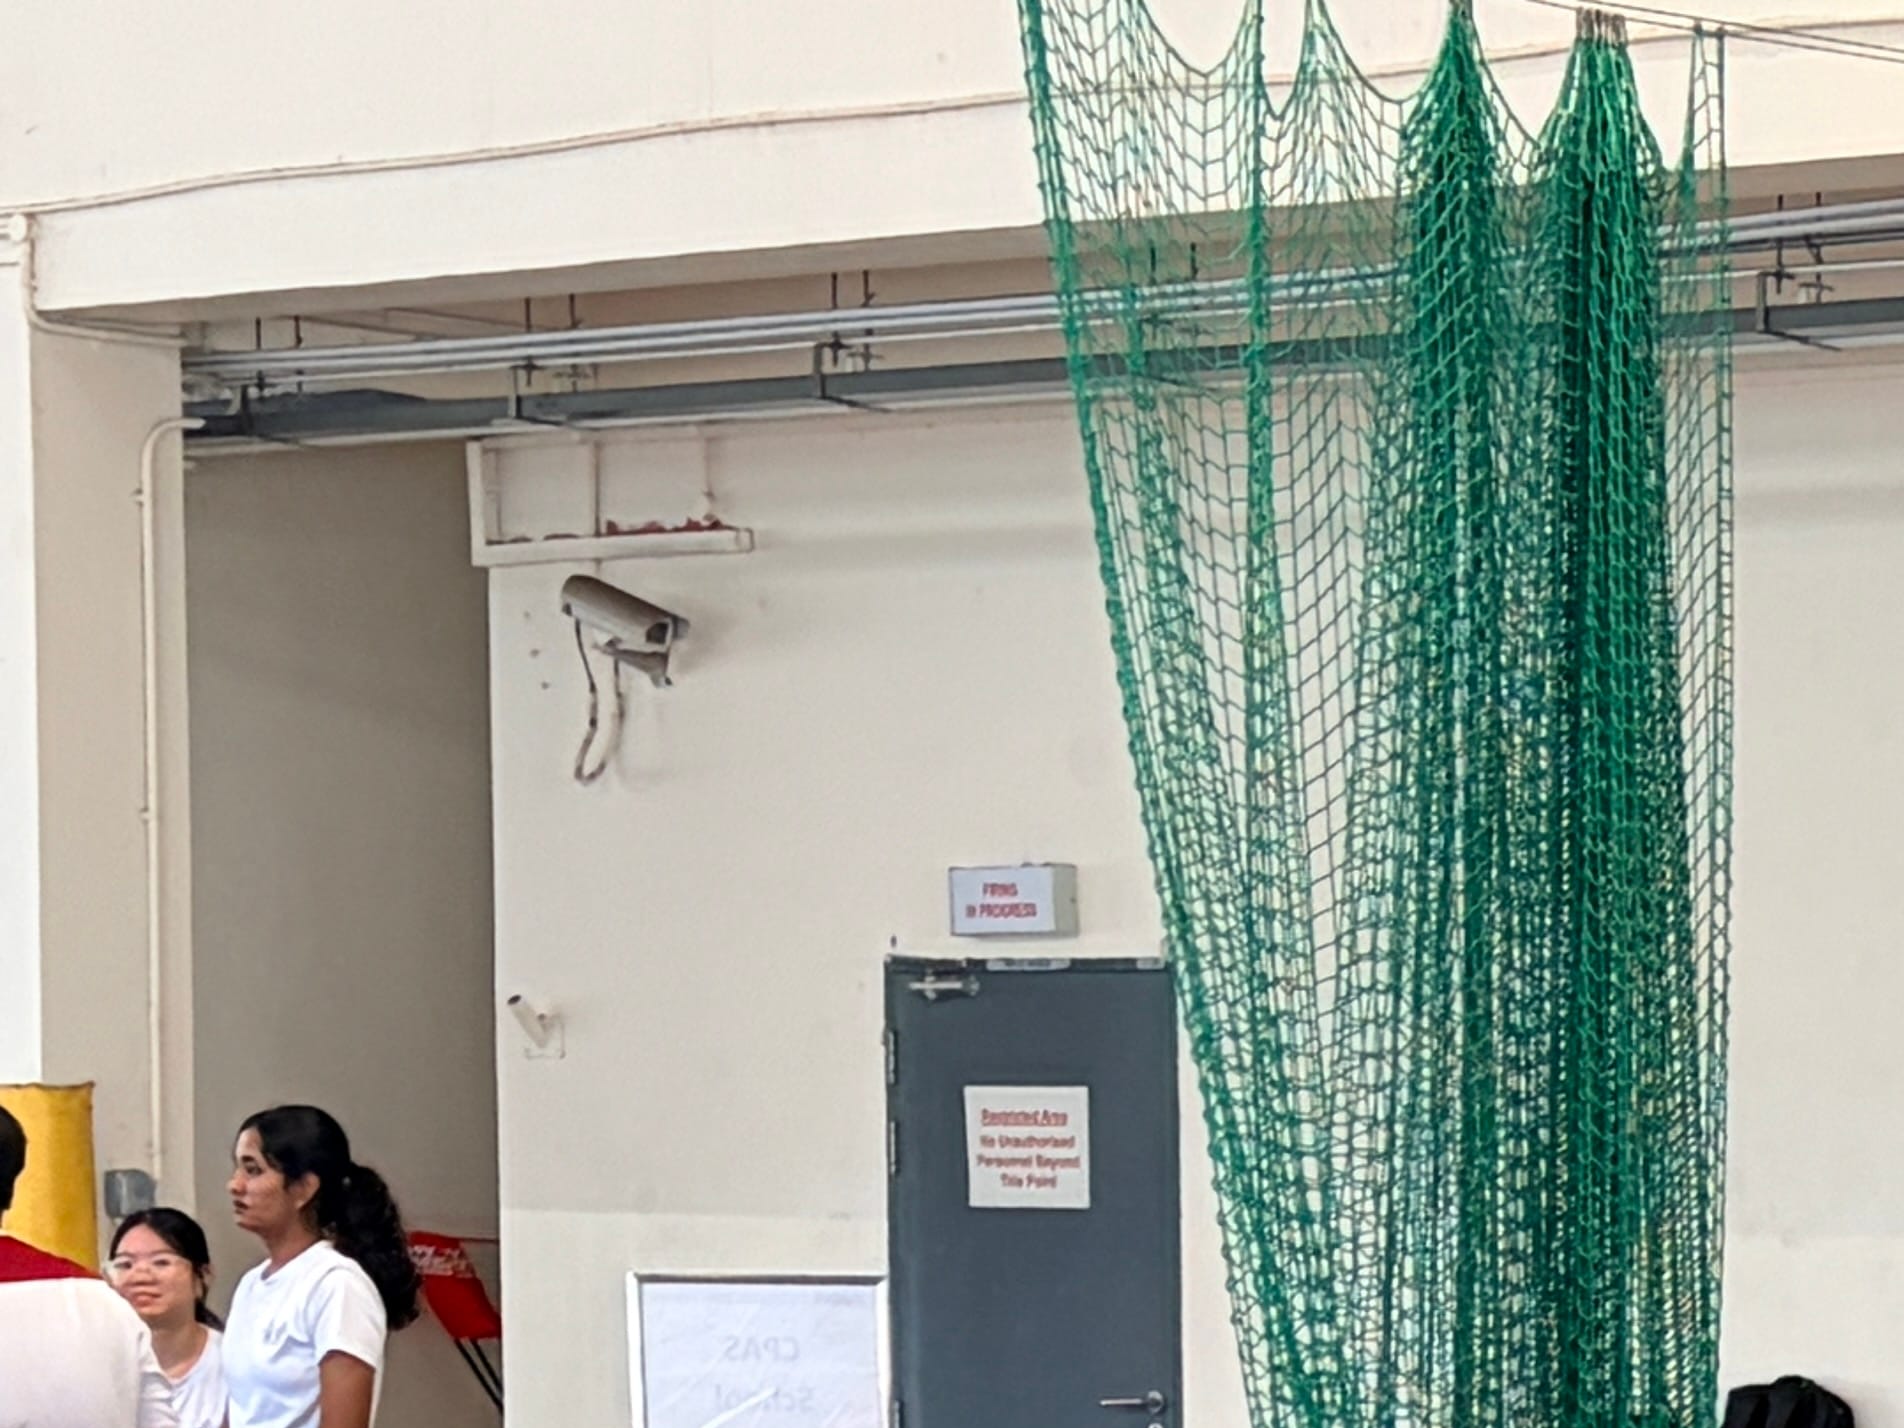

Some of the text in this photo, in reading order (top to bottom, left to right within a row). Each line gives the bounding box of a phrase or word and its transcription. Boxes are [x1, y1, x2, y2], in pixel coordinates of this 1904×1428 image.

[982, 882, 1018, 897] FIRING
[980, 903, 1037, 918] PROGRESS
[1041, 1109, 1068, 1127] Area
[980, 1135, 995, 1148] No
[1036, 1154, 1081, 1171] Beyond
[1000, 1173, 1058, 1189] This Point
